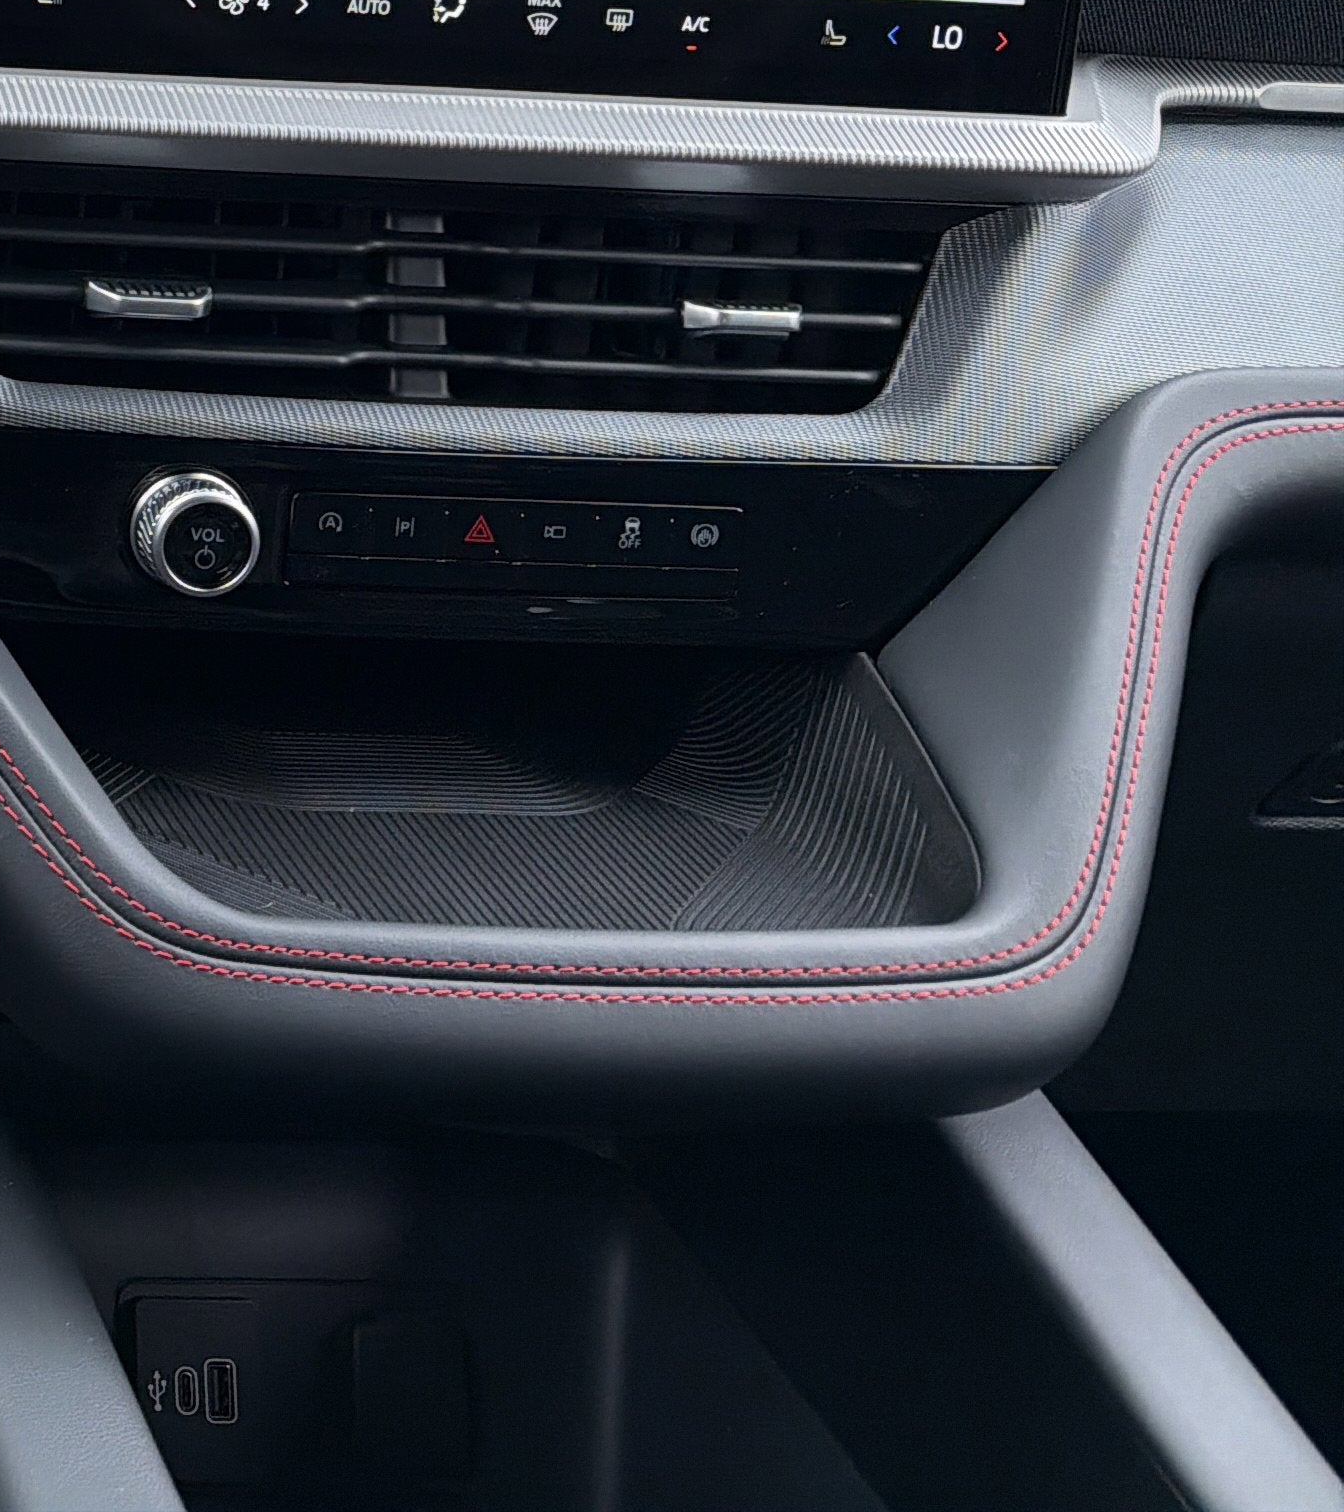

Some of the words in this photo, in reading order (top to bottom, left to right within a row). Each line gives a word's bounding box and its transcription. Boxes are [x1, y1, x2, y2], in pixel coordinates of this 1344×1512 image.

[681, 15, 711, 33] A/C
[931, 24, 963, 50] LO
[190, 528, 225, 543] VOL
[618, 537, 641, 550] OFF
